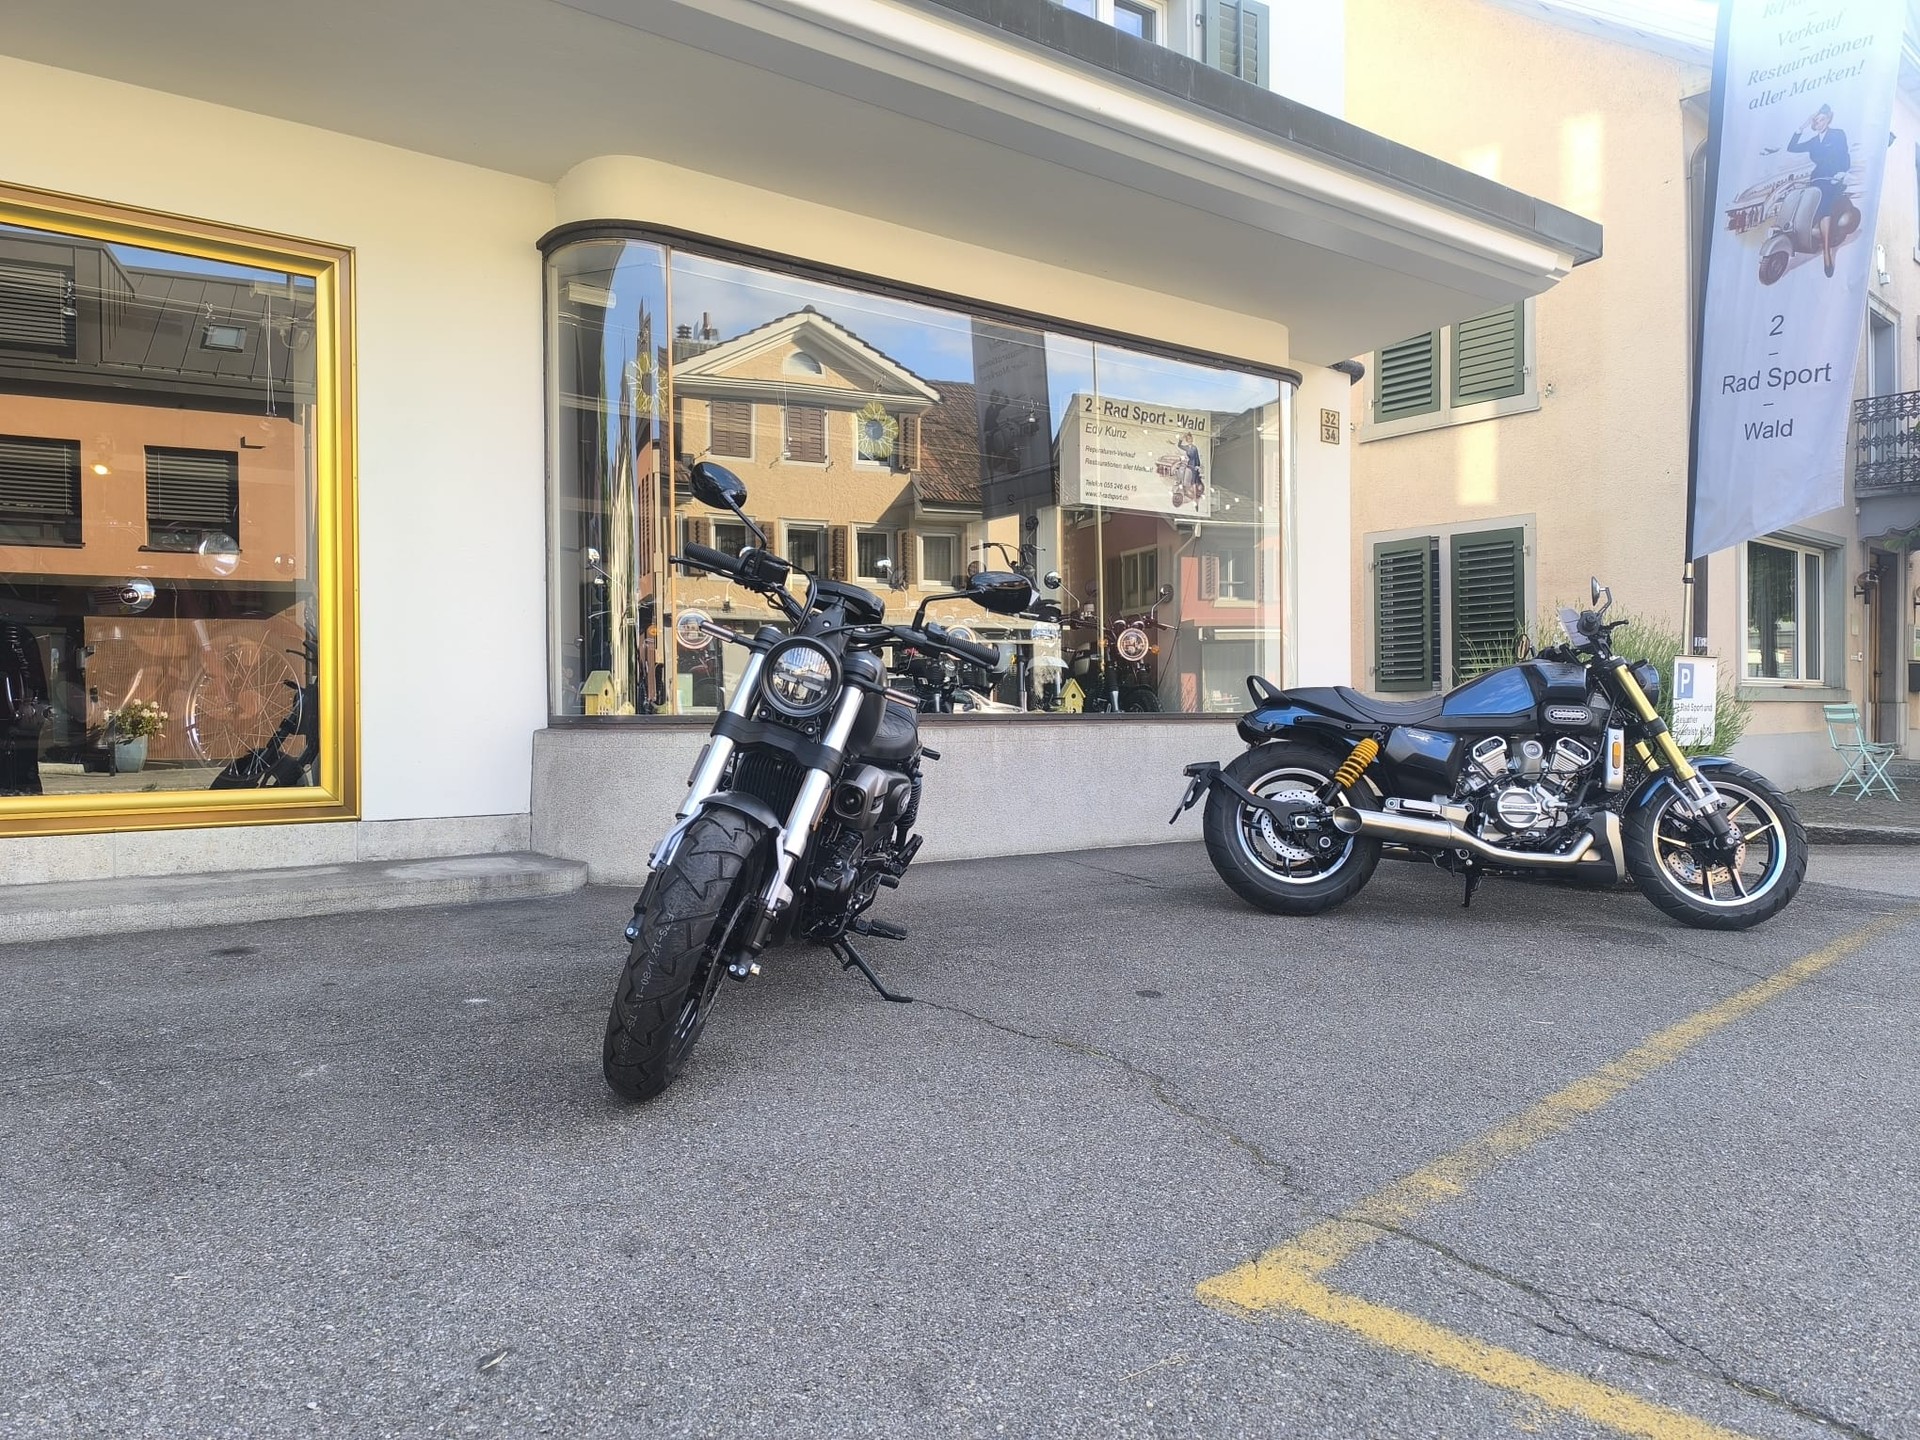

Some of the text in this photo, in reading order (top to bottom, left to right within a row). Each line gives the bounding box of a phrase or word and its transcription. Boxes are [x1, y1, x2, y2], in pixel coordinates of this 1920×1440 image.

[1777, 8, 1847, 46] Verkauf
[1747, 34, 1875, 86] Restaurationen
[1749, 59, 1865, 110] aller Marken!
[1769, 314, 1784, 336] 2
[1722, 363, 1832, 395] Rad Sport
[1085, 397, 1093, 412] 2
[1103, 401, 1129, 418] Rad
[1132, 406, 1166, 425] Sport
[1177, 413, 1206, 432] Wald
[1325, 411, 1337, 425] 32
[1104, 425, 1128, 439] Kunz
[1325, 428, 1336, 442] 34
[1744, 418, 1793, 440] Wald
[1681, 668, 1691, 694] P
